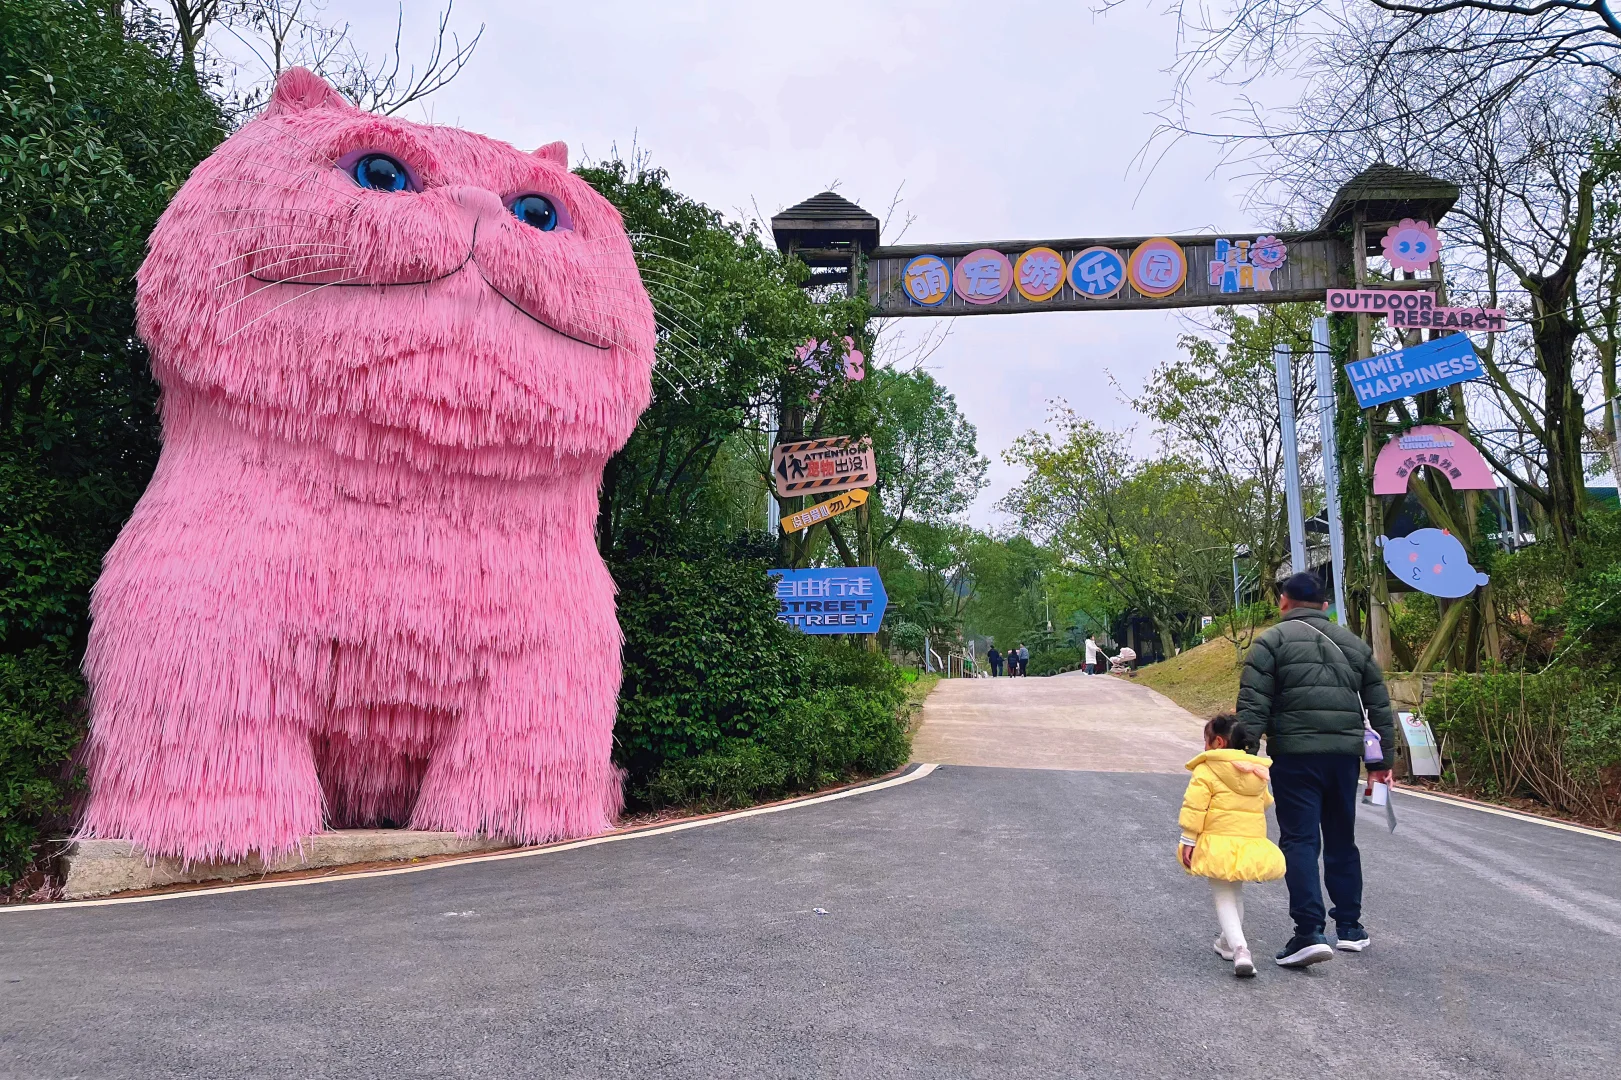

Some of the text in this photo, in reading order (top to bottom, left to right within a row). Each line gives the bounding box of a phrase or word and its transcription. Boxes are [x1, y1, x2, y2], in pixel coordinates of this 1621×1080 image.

[1215, 239, 1250, 268] PET
[907, 249, 1180, 299] 萌宠游乐园
[1209, 261, 1274, 293] PARK
[1330, 293, 1433, 310] OUTDOOR
[1393, 310, 1502, 329] RESEARCH
[1350, 353, 1404, 382] LIMIT
[1357, 354, 1477, 401] HAPPINESS
[804, 445, 867, 461] ATTENTION
[775, 577, 873, 598] 自由行走
